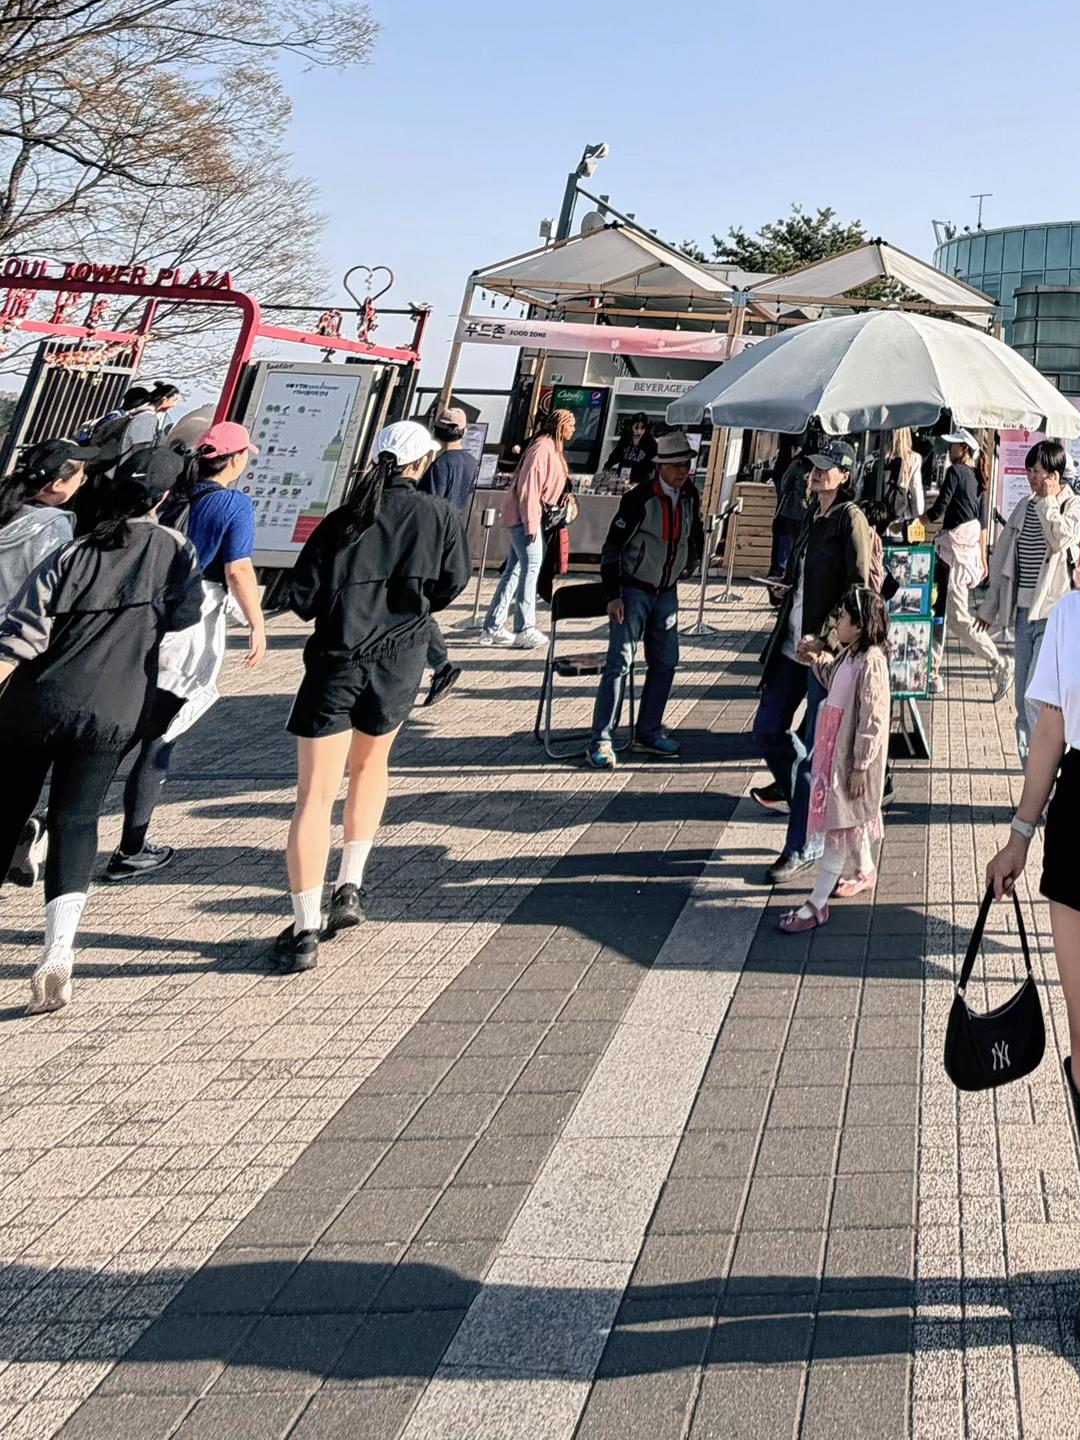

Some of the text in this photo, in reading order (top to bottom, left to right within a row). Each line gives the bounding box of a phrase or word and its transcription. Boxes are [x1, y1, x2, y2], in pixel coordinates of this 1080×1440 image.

[0, 257, 231, 290] OUL TOWER PLAZA
[464, 322, 506, 339] 푸드존
[529, 330, 547, 338] ZONE
[634, 382, 682, 393] BEVERAGE
[991, 1040, 1011, 1071] NY
